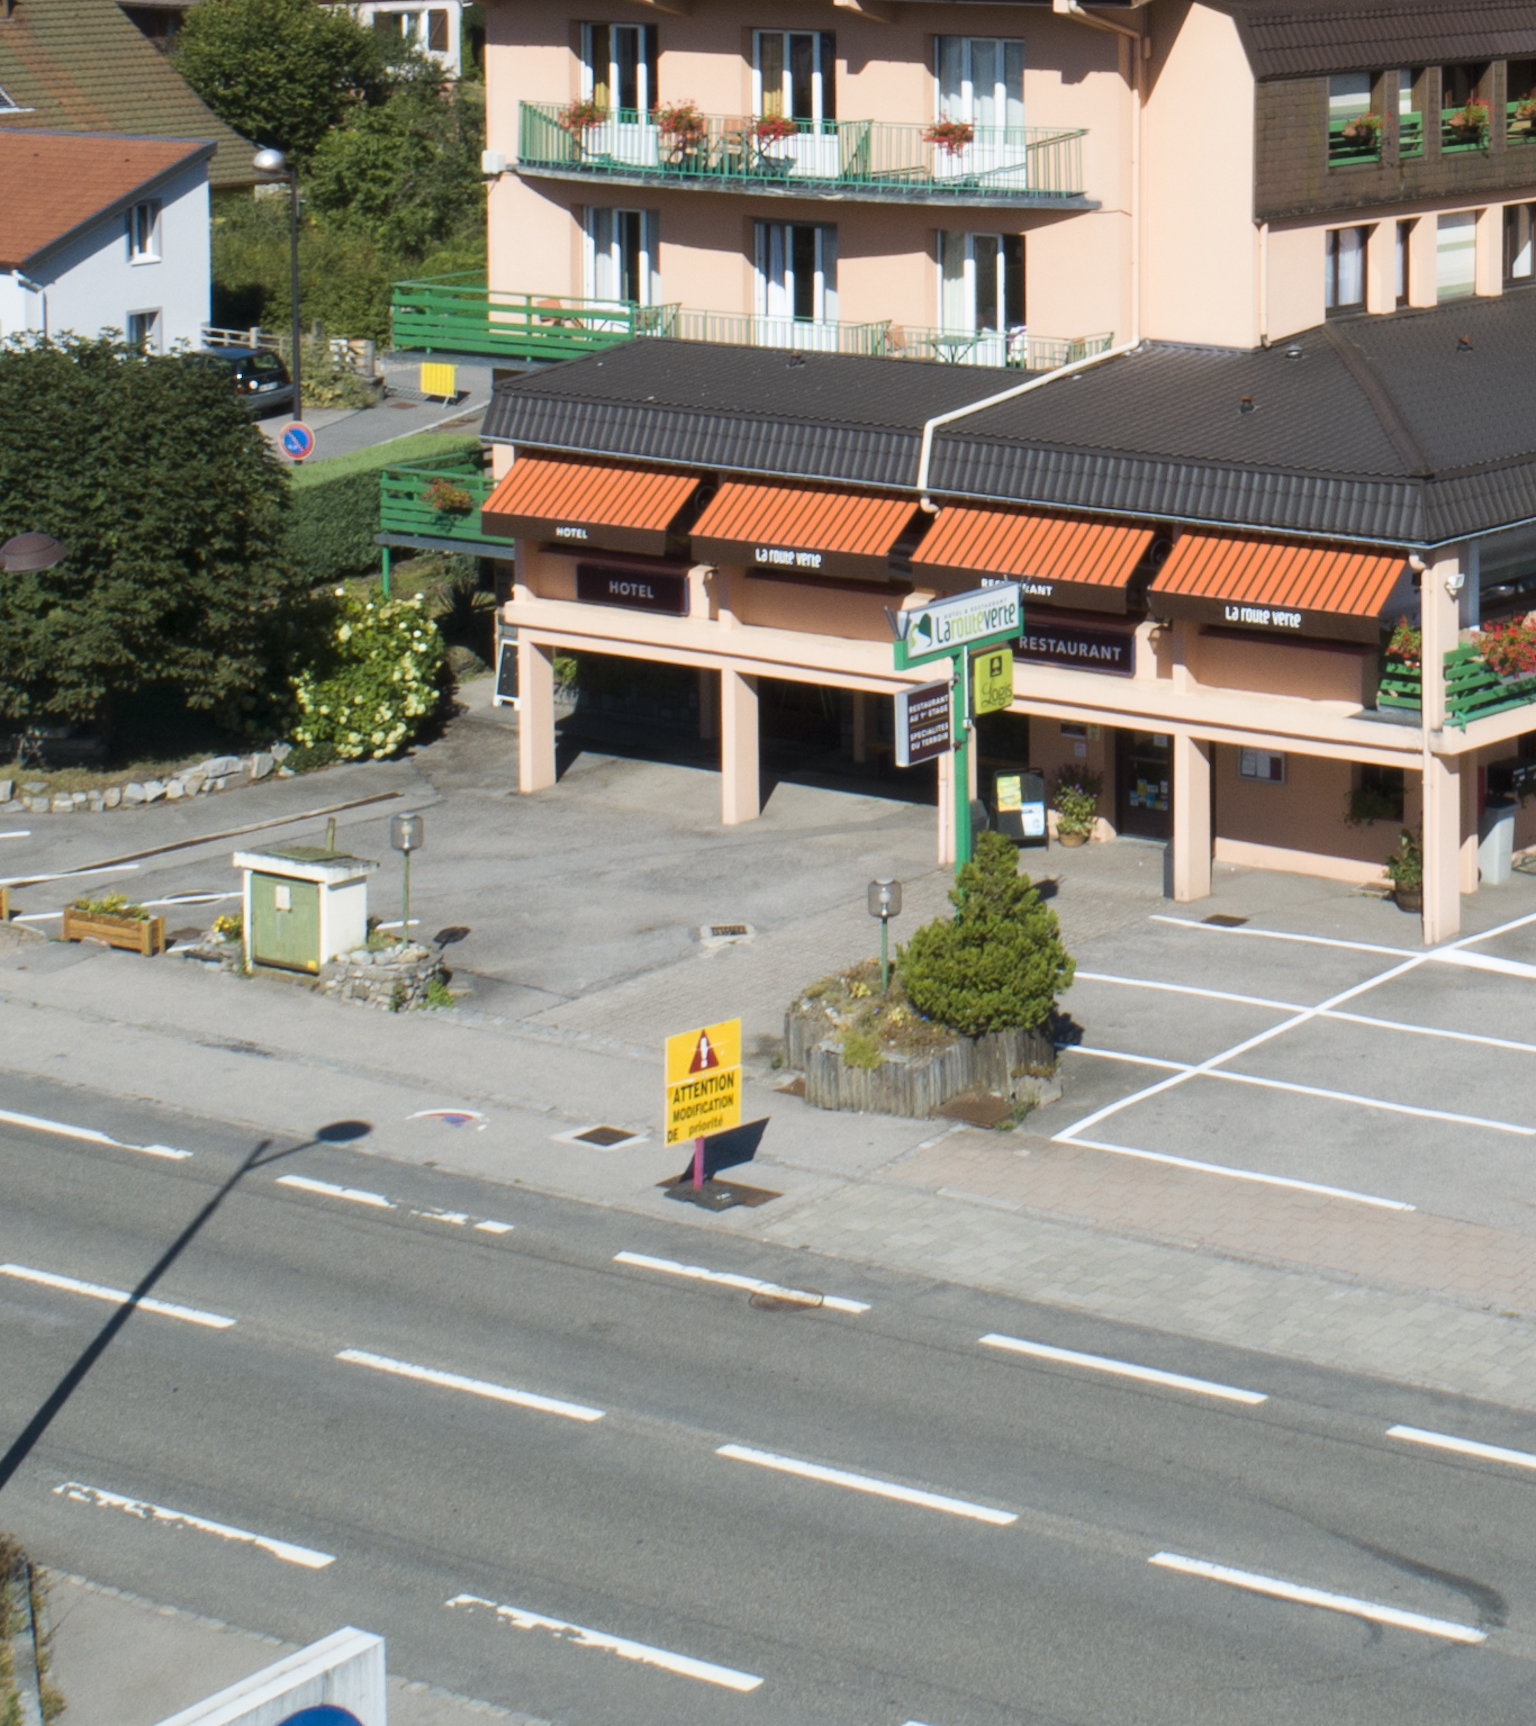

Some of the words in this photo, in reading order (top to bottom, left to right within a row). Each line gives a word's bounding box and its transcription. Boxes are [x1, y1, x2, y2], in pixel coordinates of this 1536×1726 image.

[555, 526, 588, 539] HOTEL
[755, 547, 768, 563] La
[769, 549, 795, 565] route
[796, 552, 822, 568] verte
[609, 581, 654, 599] HOTEL
[1225, 606, 1239, 621] La
[1240, 607, 1270, 625] route
[1272, 610, 1302, 628] verte
[1019, 636, 1122, 661] RESTAURANT
[909, 694, 949, 714] RESTAURANT
[910, 713, 919, 723] AU
[911, 741, 921, 751] DU
[673, 1072, 735, 1105] ATTENTION
[673, 1093, 735, 1123] MODIFICATION
[667, 1127, 680, 1144] DE
